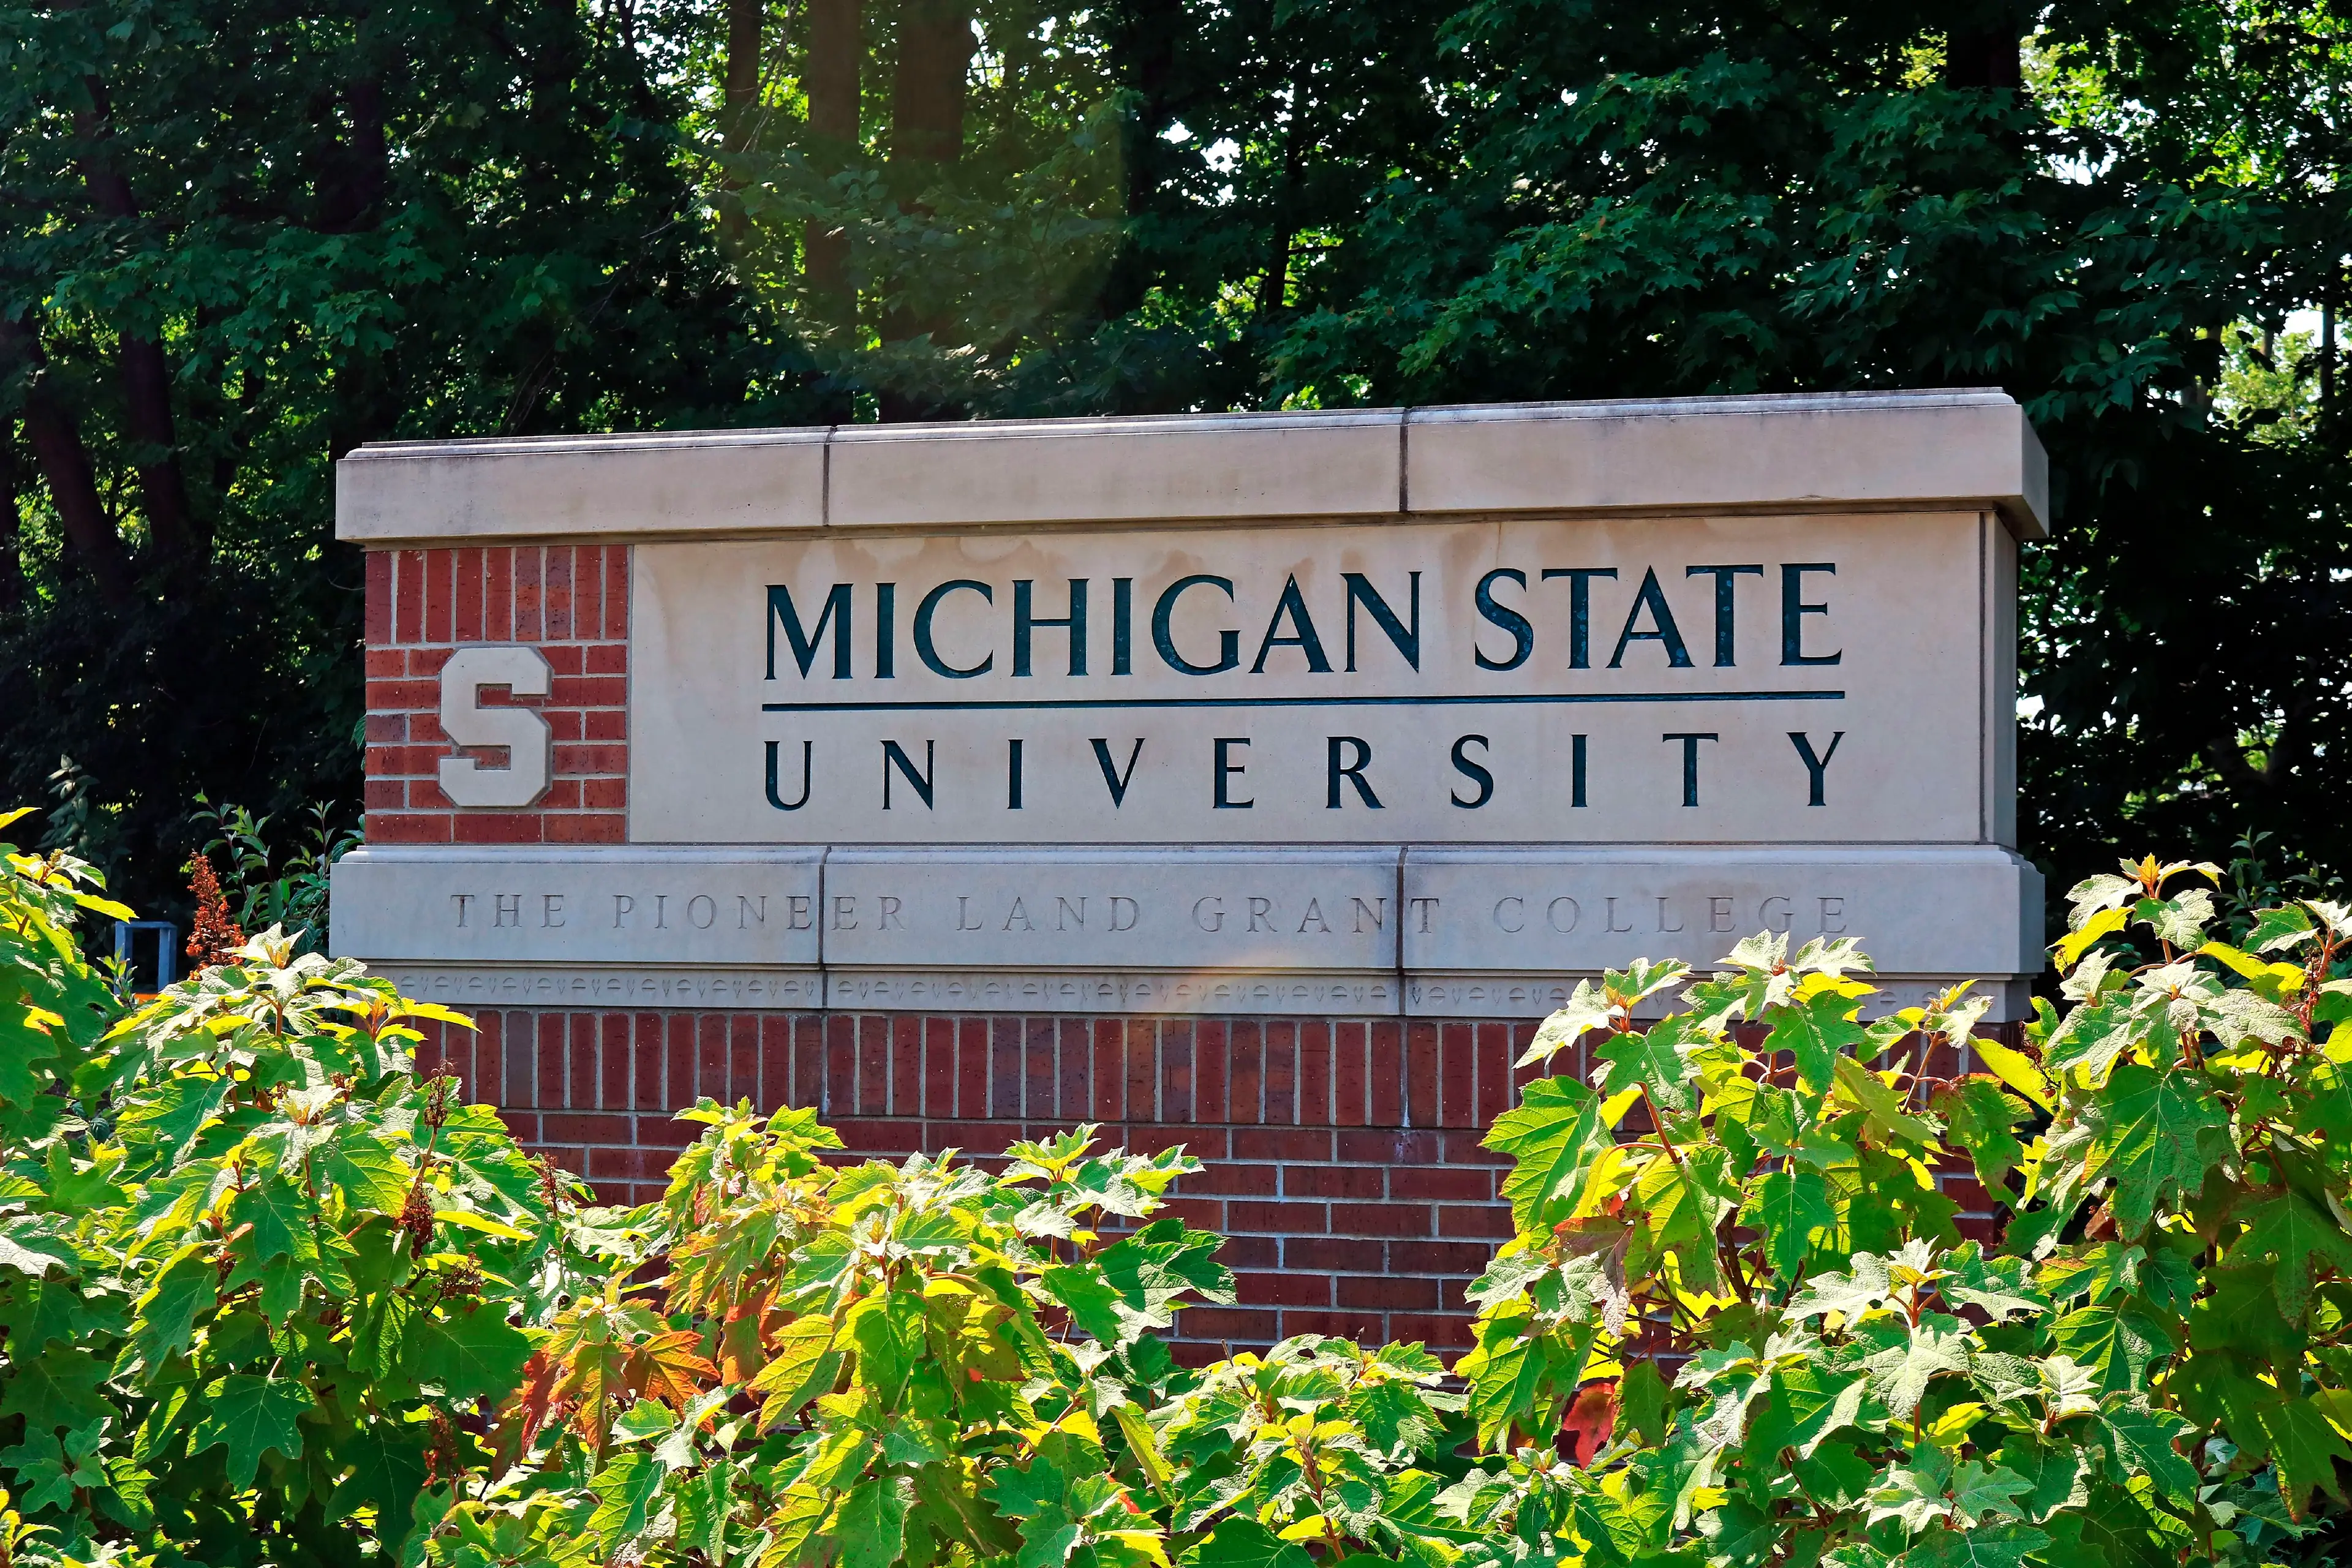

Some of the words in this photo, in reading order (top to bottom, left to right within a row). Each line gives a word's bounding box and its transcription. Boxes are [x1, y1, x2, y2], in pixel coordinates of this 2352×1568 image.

[763, 571, 1423, 680] MICHIGAN
[1474, 562, 1842, 671] STATE
[439, 647, 552, 807] S
[764, 731, 1846, 812] UNIVERSITY
[450, 894, 565, 928] THE
[613, 894, 907, 932] PIONEER
[956, 895, 1141, 932] LAND
[1191, 895, 1439, 934] GRANT
[1493, 896, 1847, 933] COLLEGE
